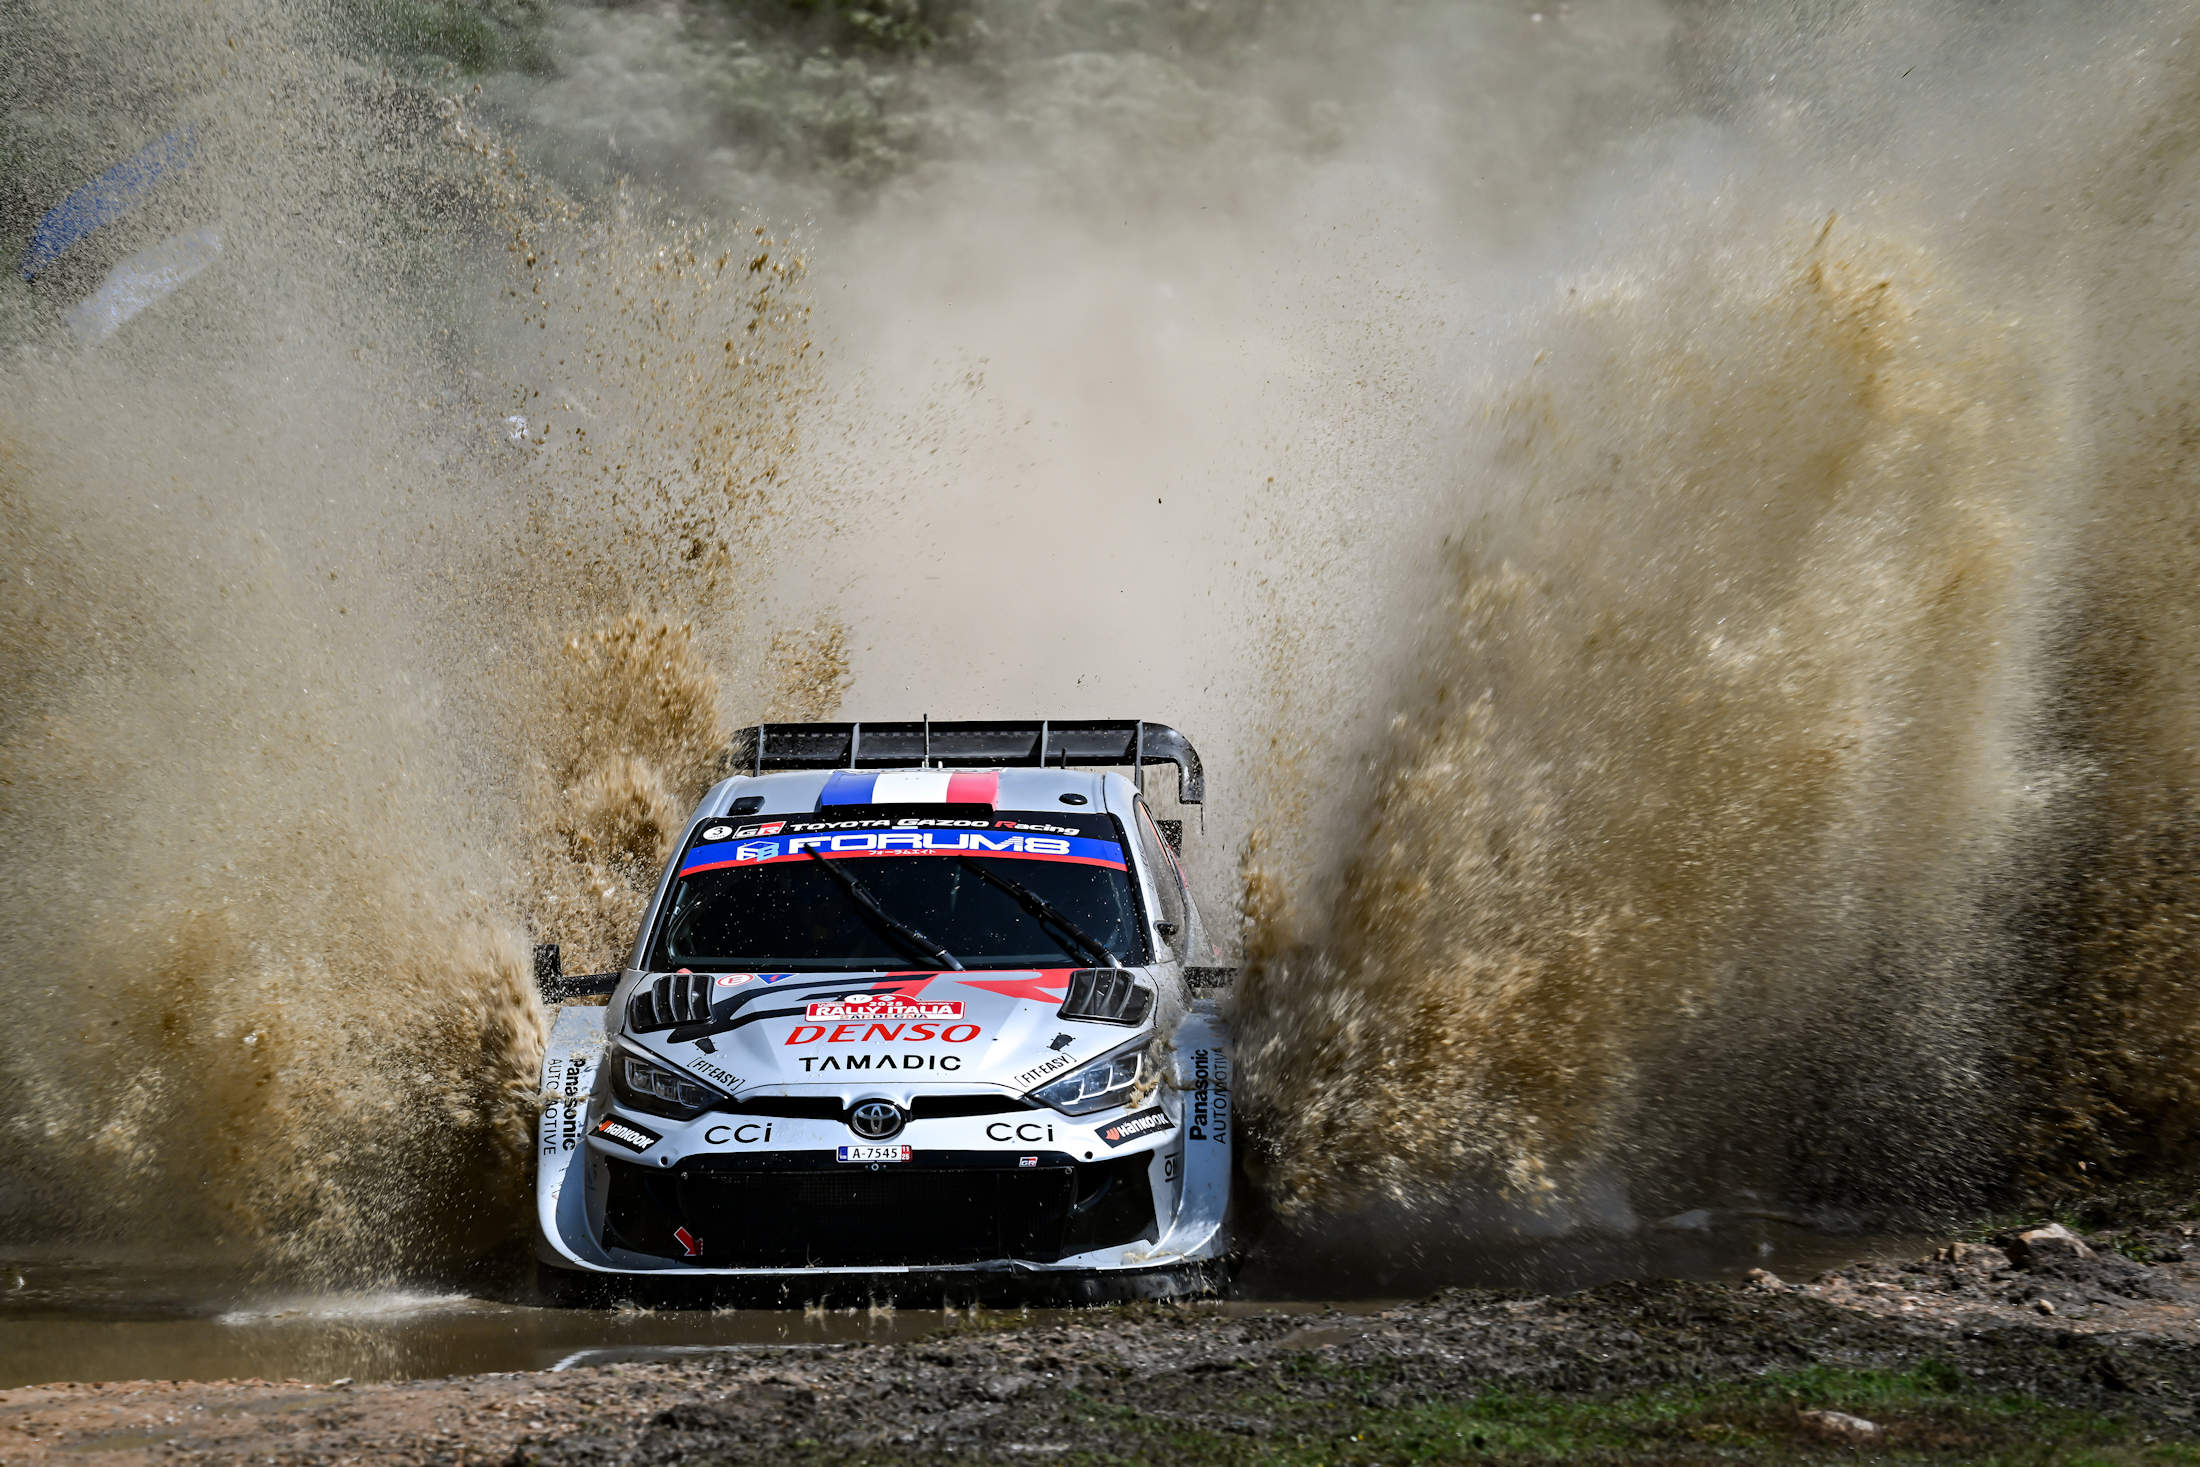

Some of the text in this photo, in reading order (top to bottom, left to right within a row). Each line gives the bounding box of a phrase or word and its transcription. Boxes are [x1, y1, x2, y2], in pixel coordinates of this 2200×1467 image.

[790, 818, 1080, 836] TOYOTA GAZOO Racing
[788, 833, 1070, 855] FORUM8
[815, 1005, 954, 1016] RALLY ITALIA
[784, 1023, 981, 1045] DENSO
[799, 1055, 961, 1072] TAMADIC
[562, 1058, 586, 1151] Panasonic
[1189, 1049, 1209, 1141] Panasonic
[852, 1148, 897, 1159] A-7545
